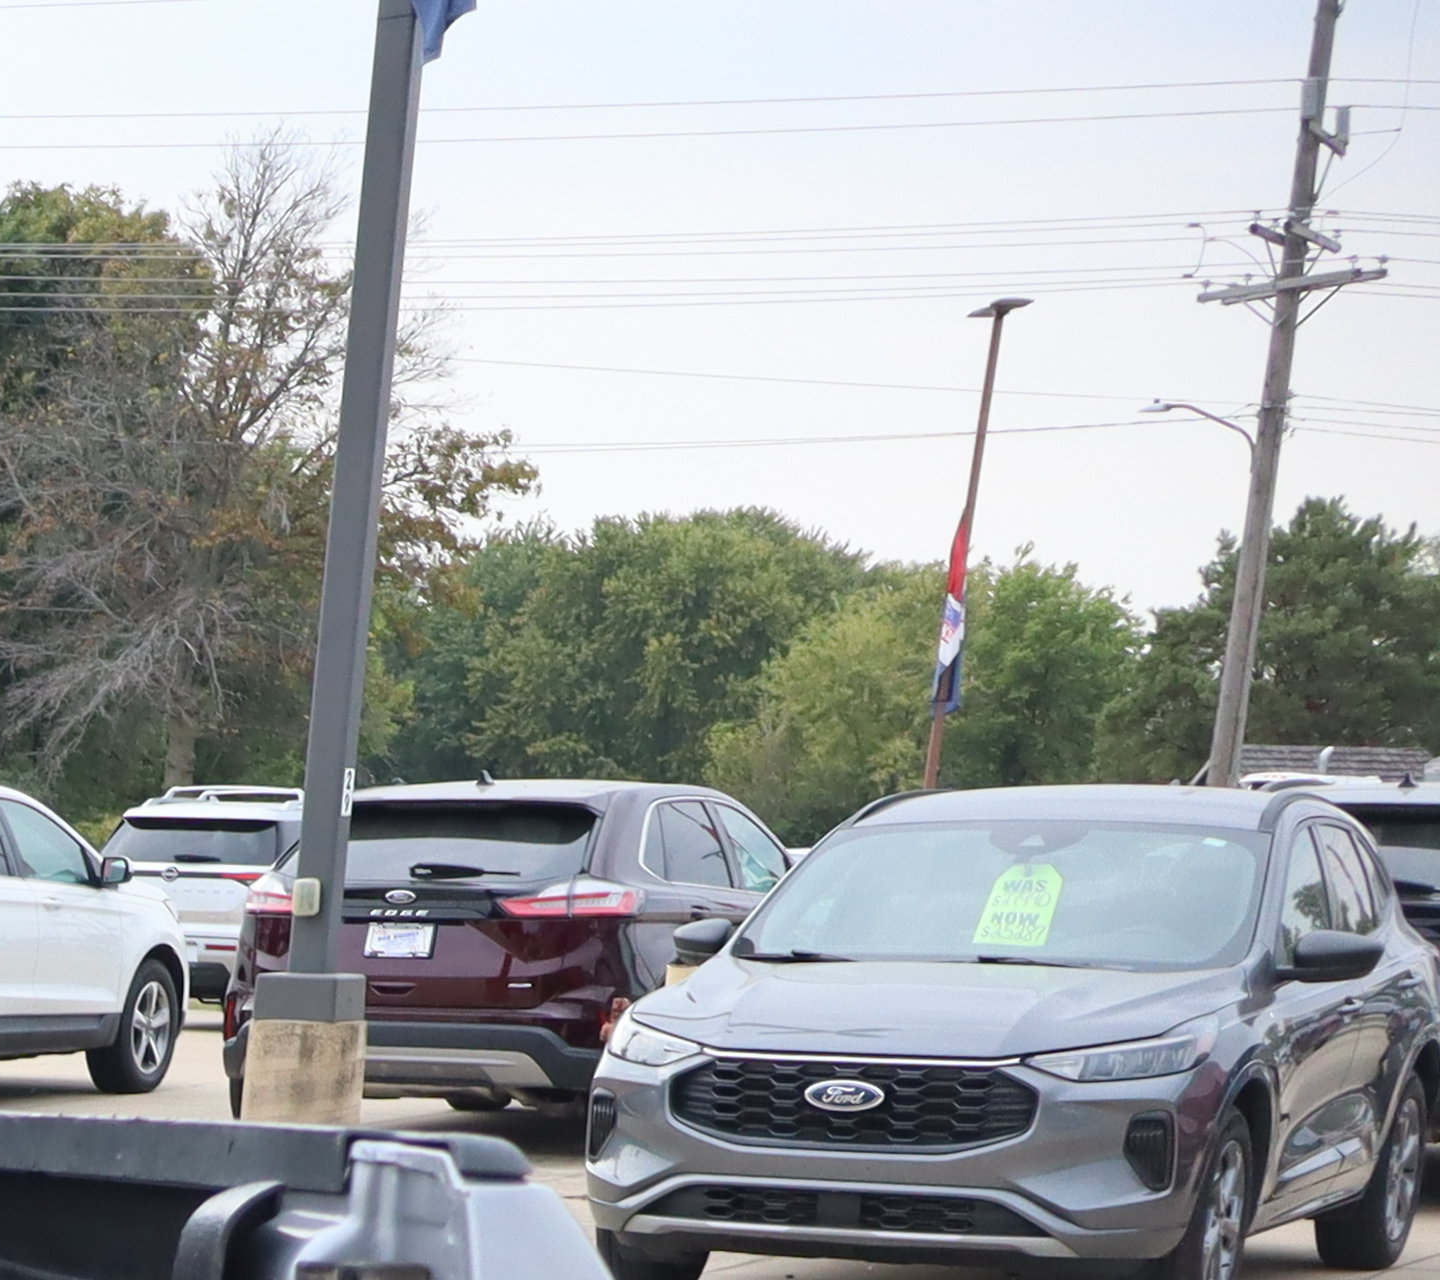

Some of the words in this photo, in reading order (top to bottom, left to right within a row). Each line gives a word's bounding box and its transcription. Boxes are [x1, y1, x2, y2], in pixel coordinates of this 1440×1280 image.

[1004, 879, 1048, 893] WAS
[991, 911, 1040, 925] NOW
[821, 1086, 866, 1105] Ford
